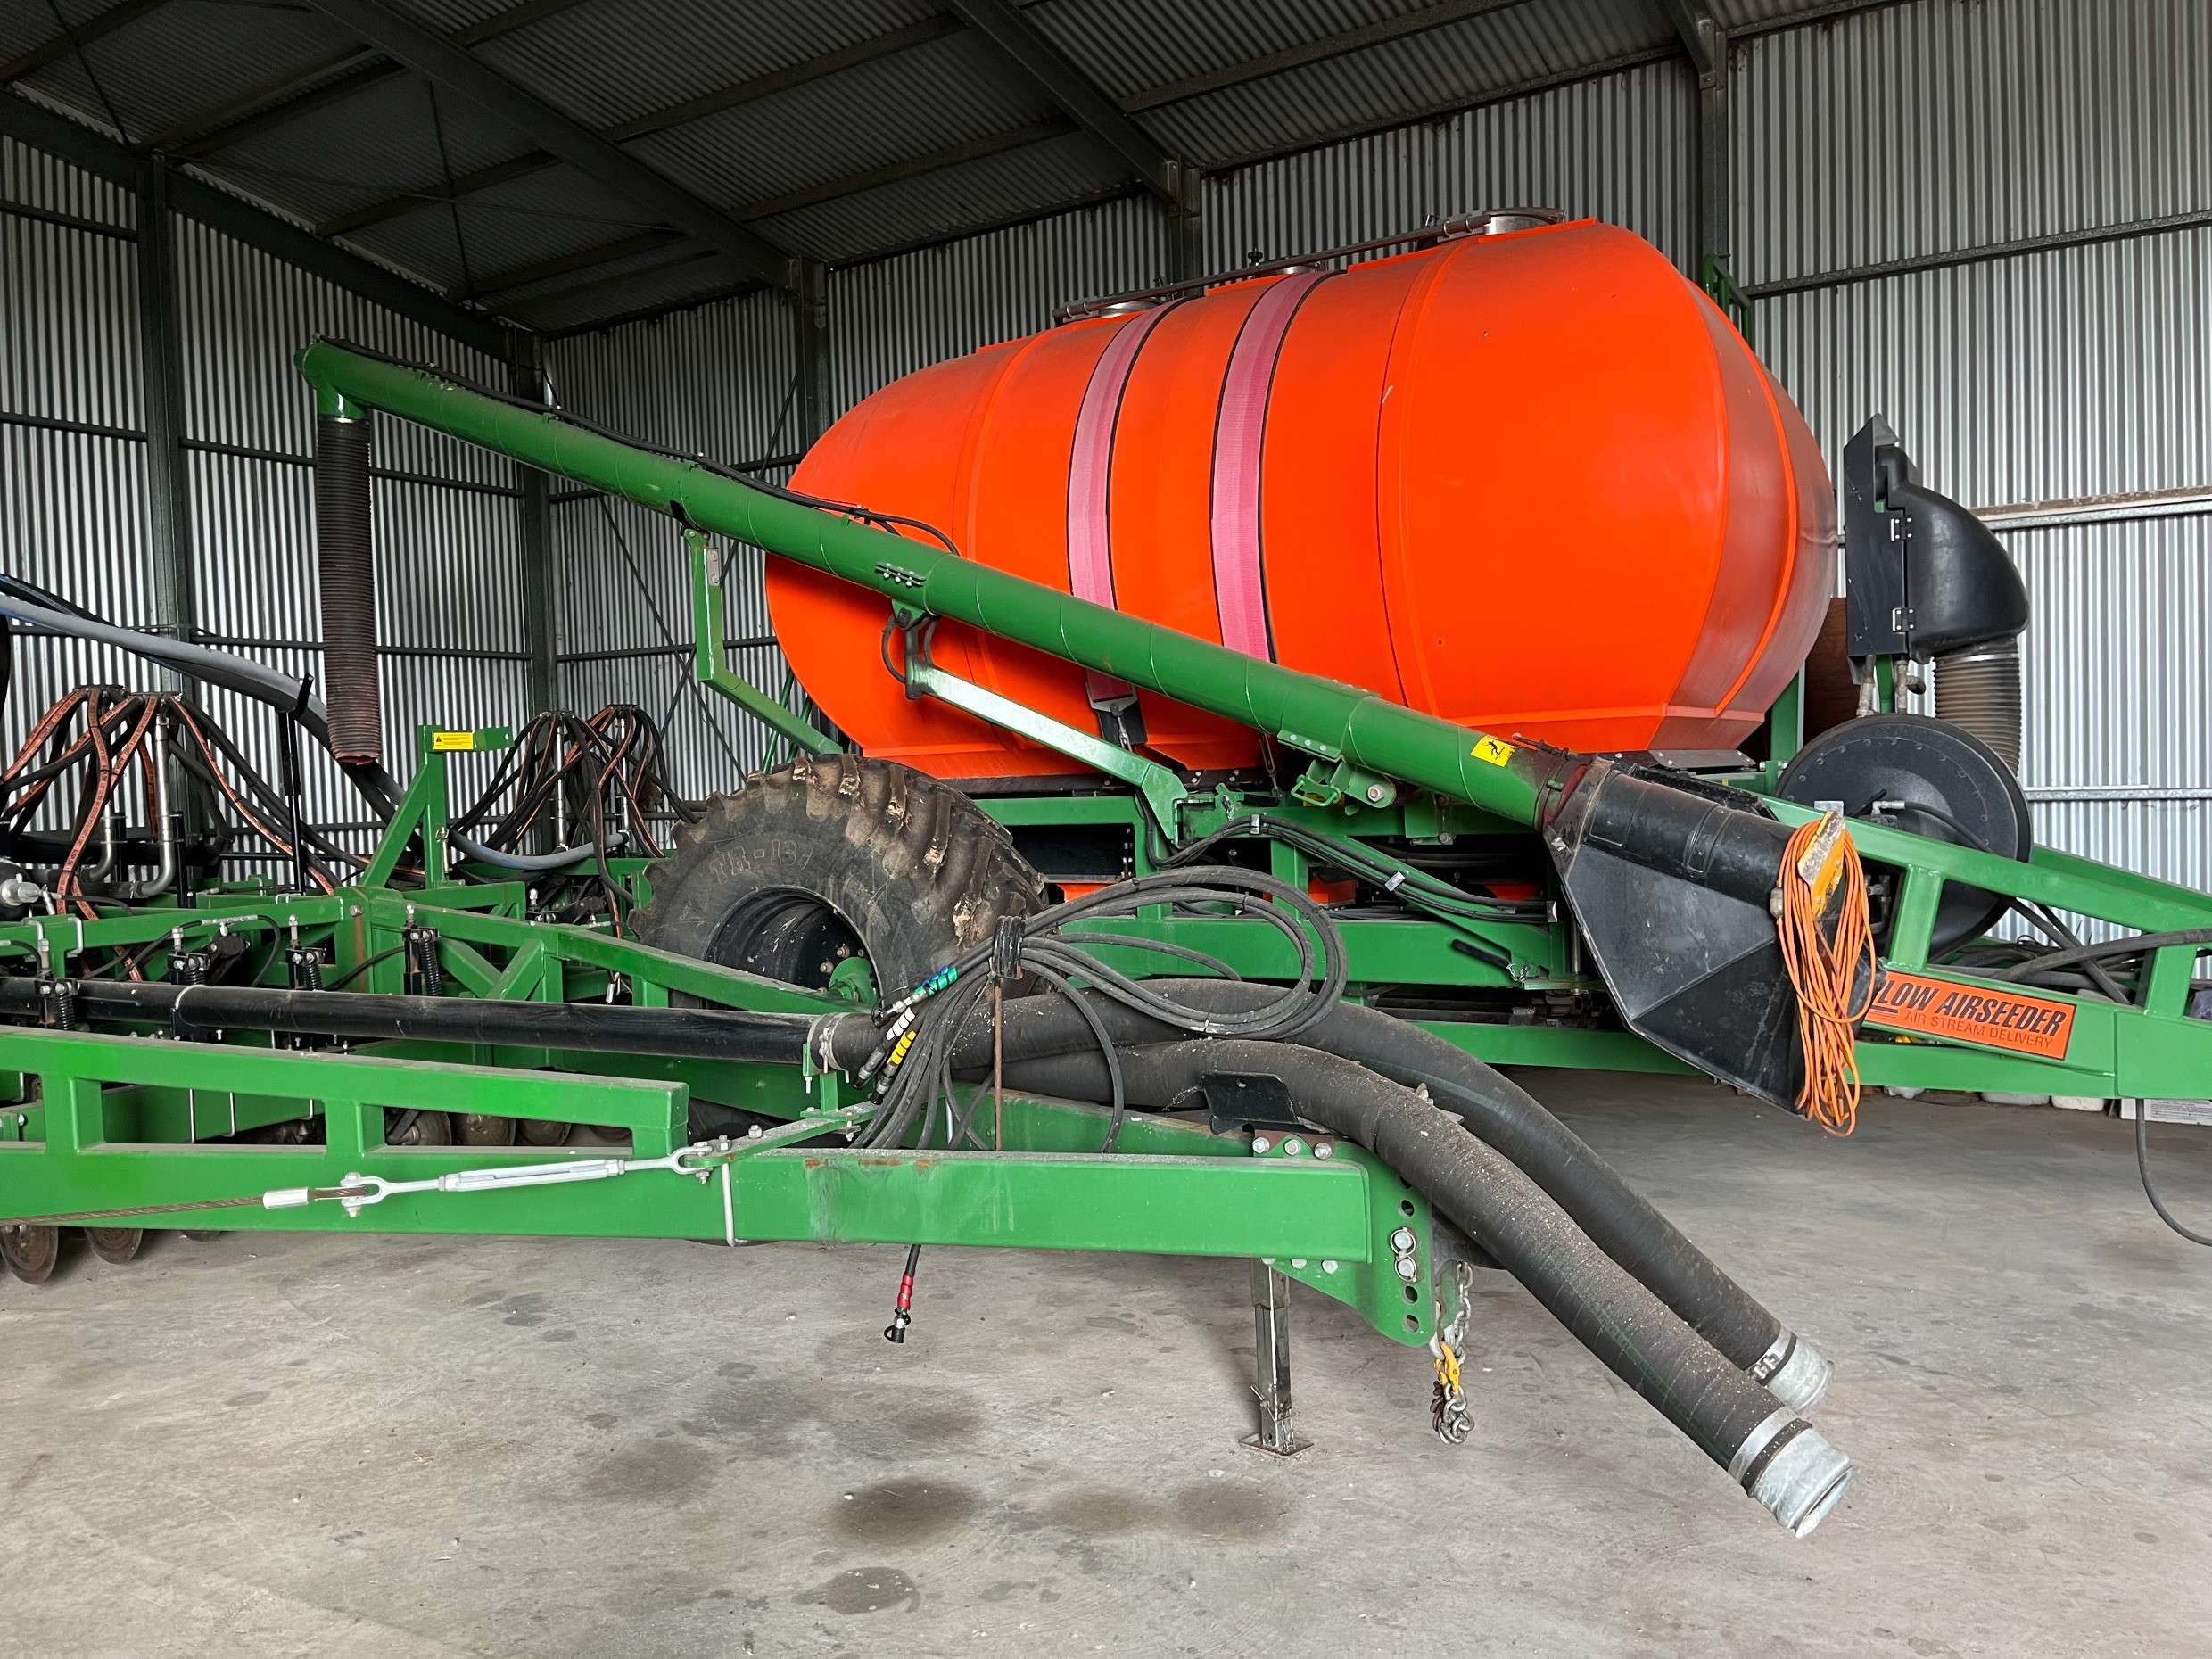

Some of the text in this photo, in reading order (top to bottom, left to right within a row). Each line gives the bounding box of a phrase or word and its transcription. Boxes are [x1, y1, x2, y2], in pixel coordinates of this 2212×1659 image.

[1877, 979, 2067, 1036] LOW AIRSEEDER
[1904, 1011, 2053, 1049] AIR STREAM DELIVERY
